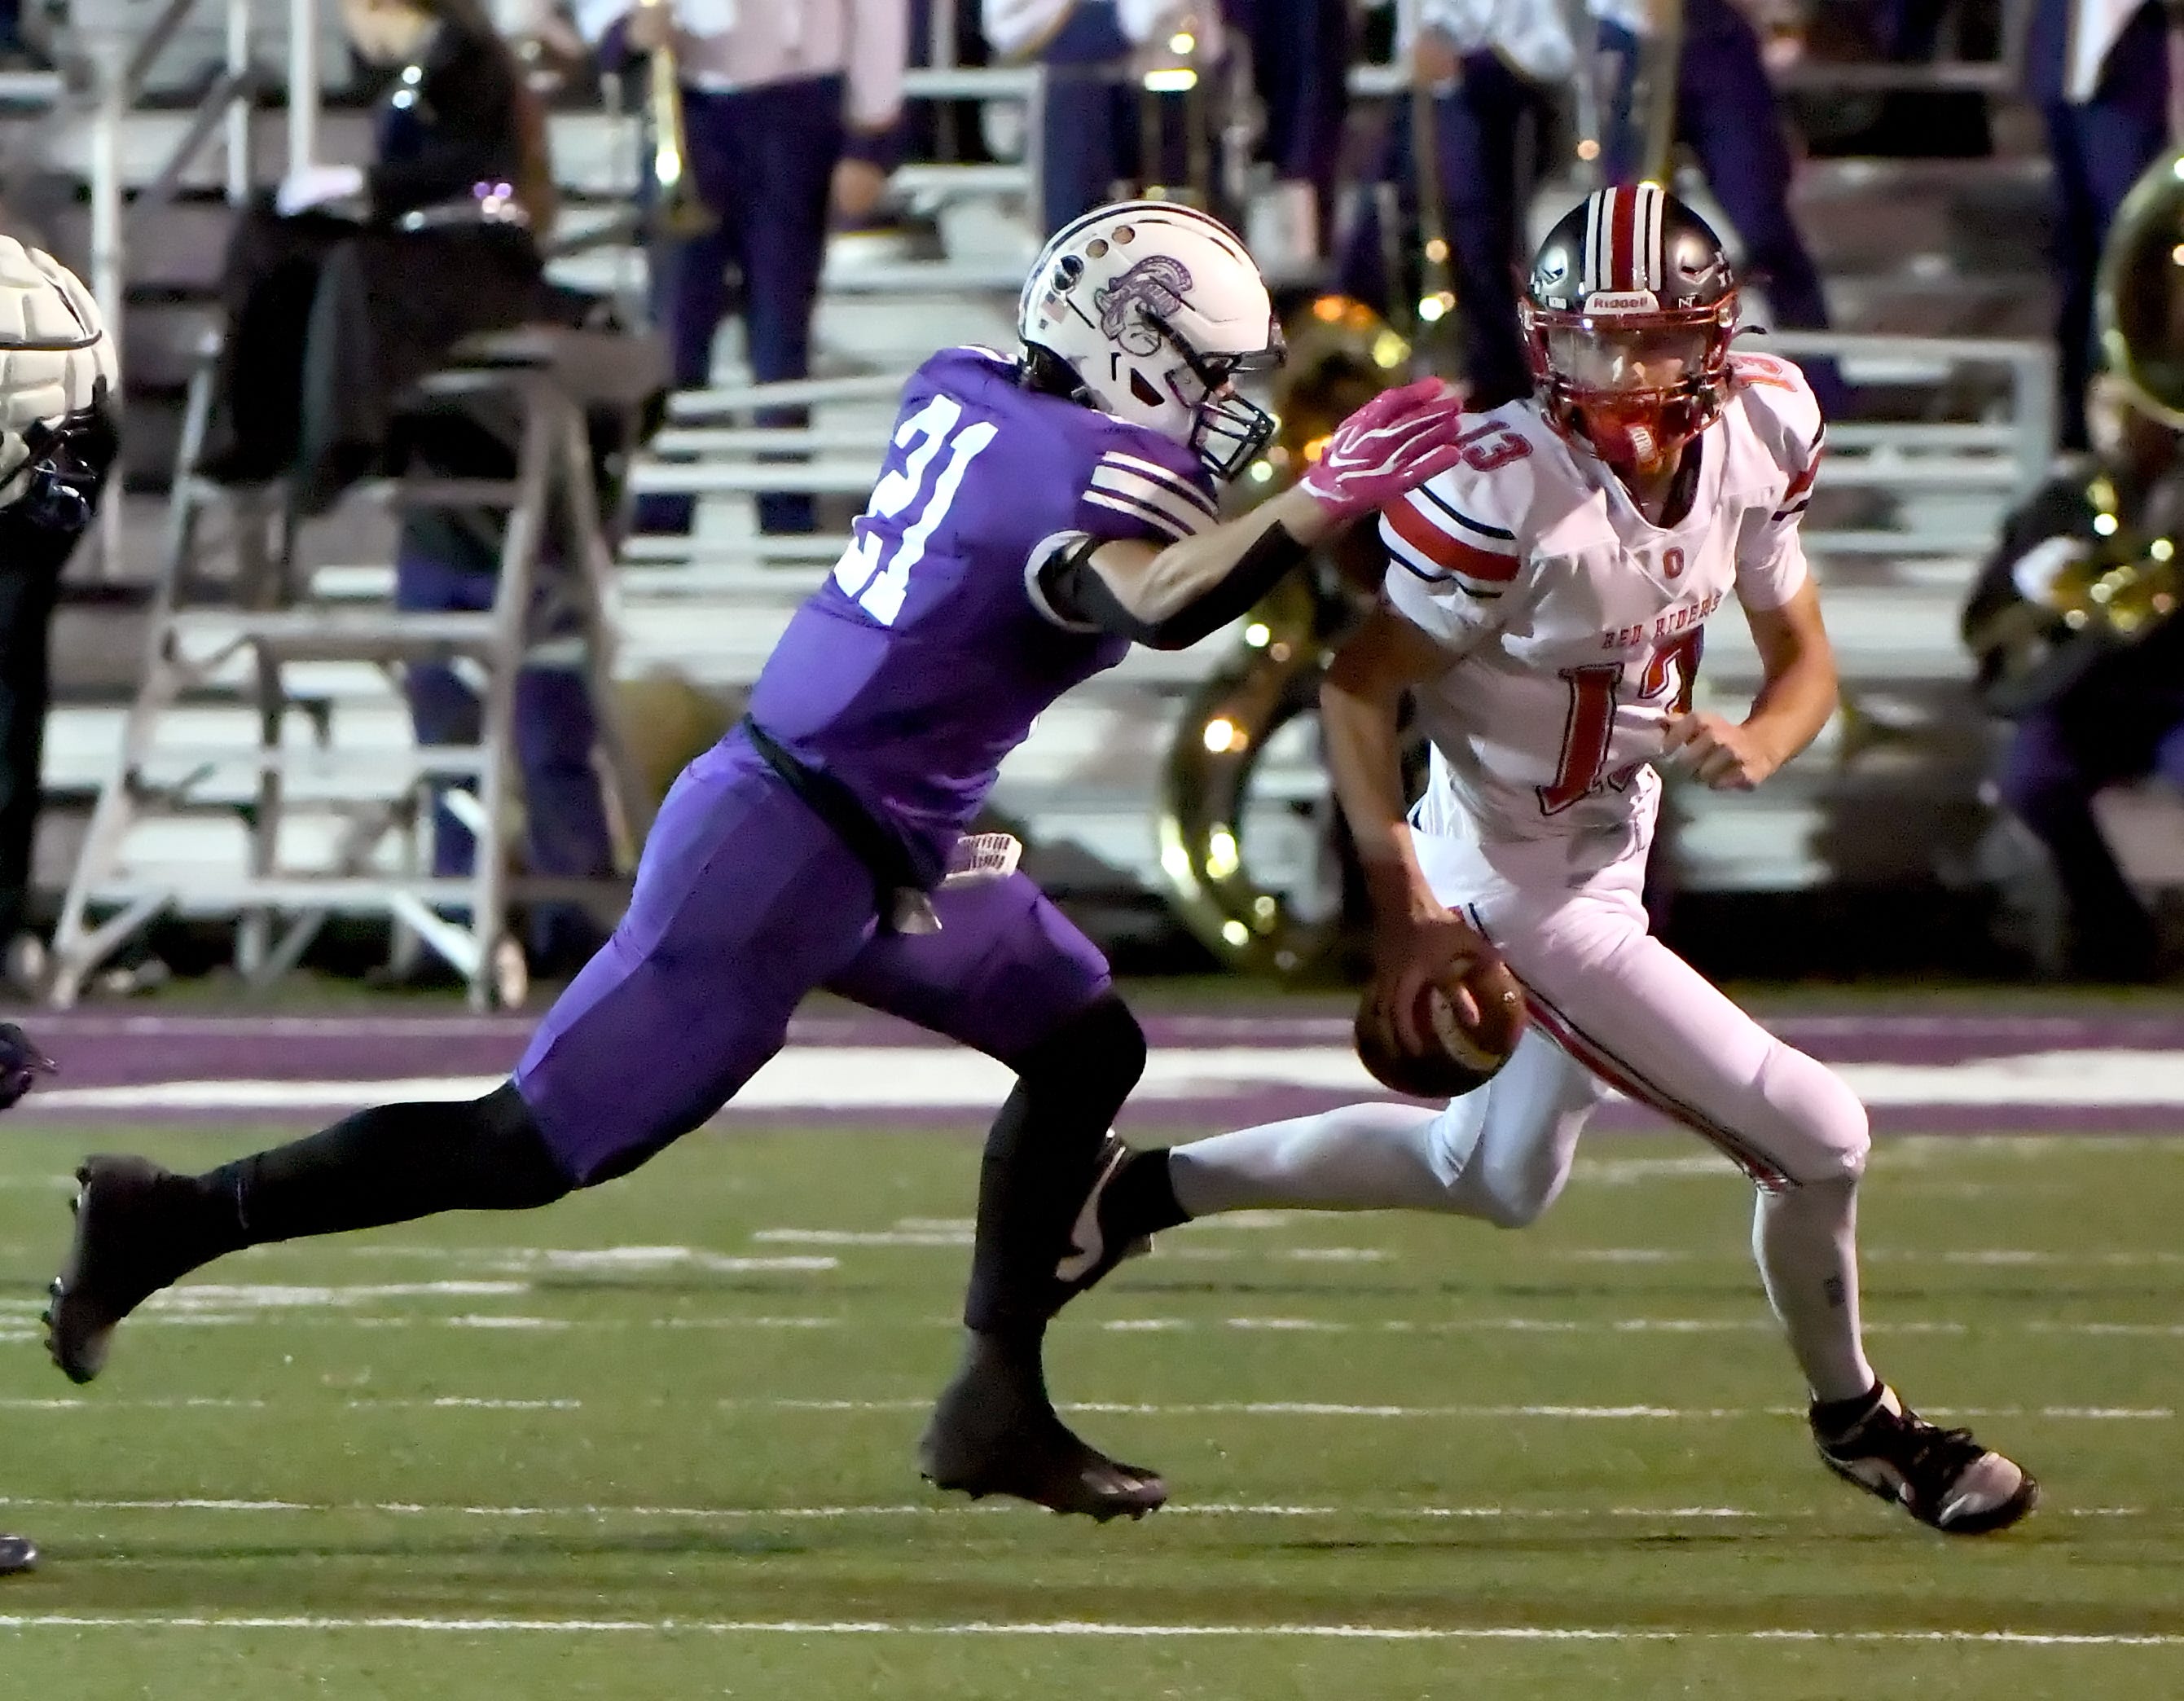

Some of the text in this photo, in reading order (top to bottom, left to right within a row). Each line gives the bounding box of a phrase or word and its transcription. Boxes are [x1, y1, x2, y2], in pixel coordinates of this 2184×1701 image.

[1593, 297, 1648, 309] Riddell
[1454, 419, 1533, 472] 13
[1602, 587, 1724, 649] RED RIDERS
